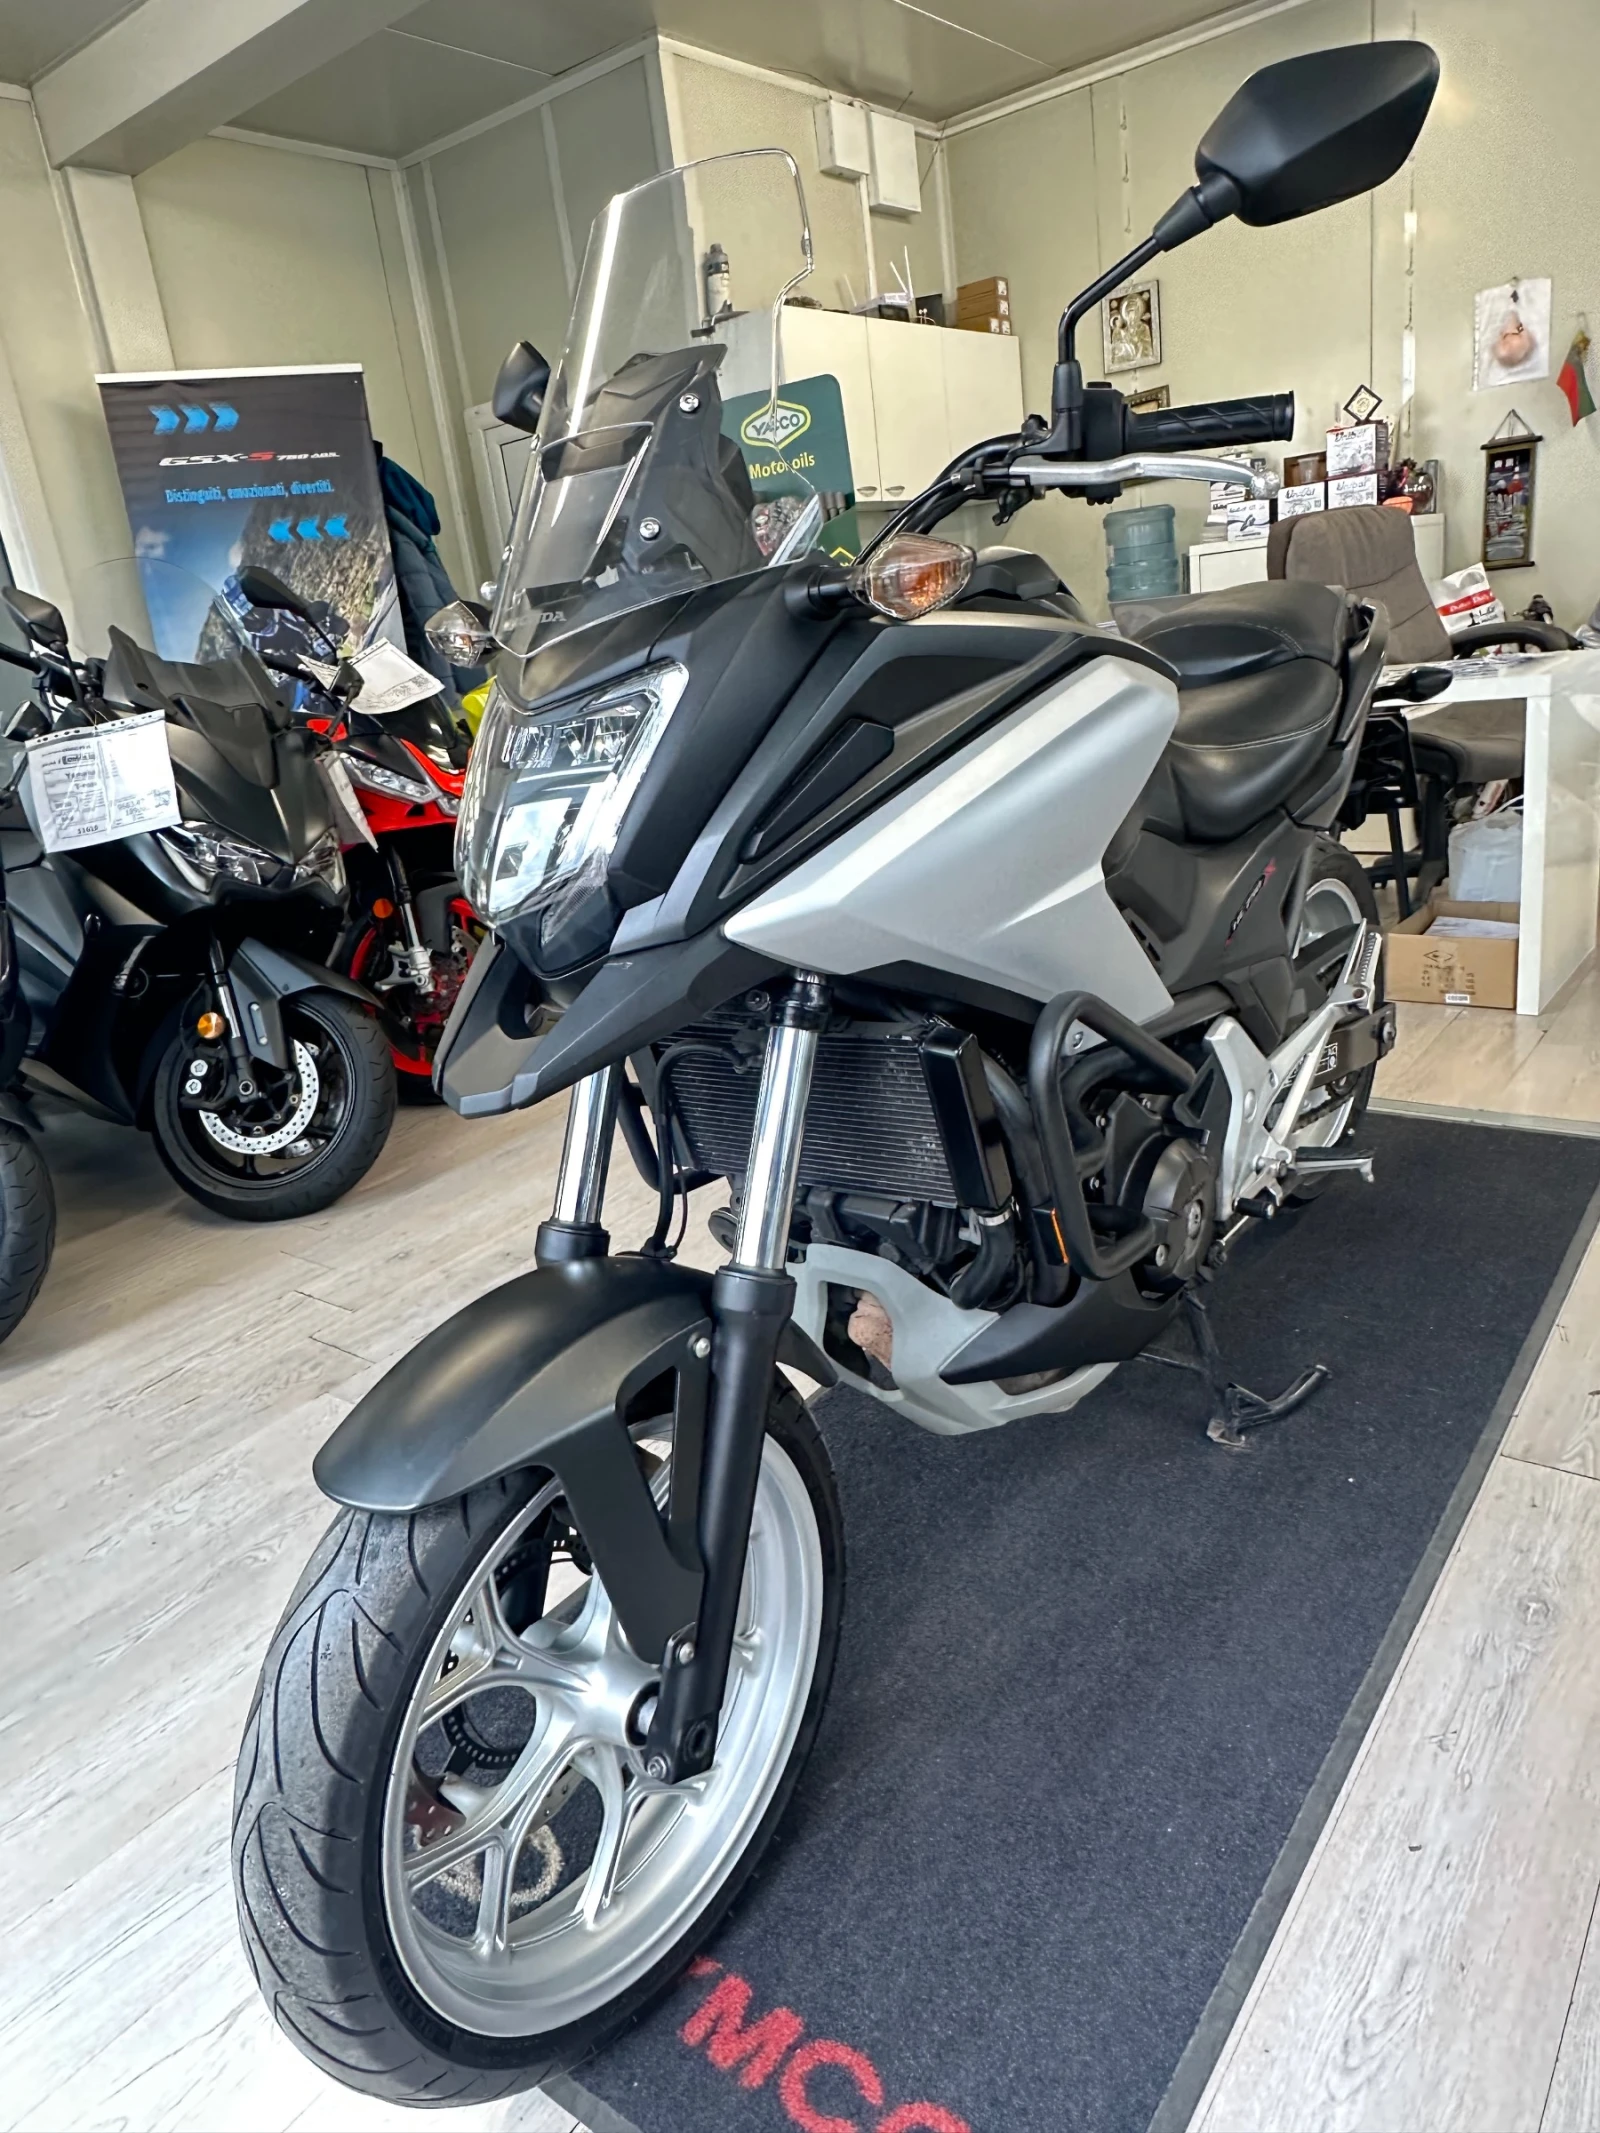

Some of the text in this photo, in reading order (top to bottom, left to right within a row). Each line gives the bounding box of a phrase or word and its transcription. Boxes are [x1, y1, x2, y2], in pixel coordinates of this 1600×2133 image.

[752, 414, 800, 437] YACCO
[159, 451, 276, 467] GSX-S
[792, 451, 815, 470] oils
